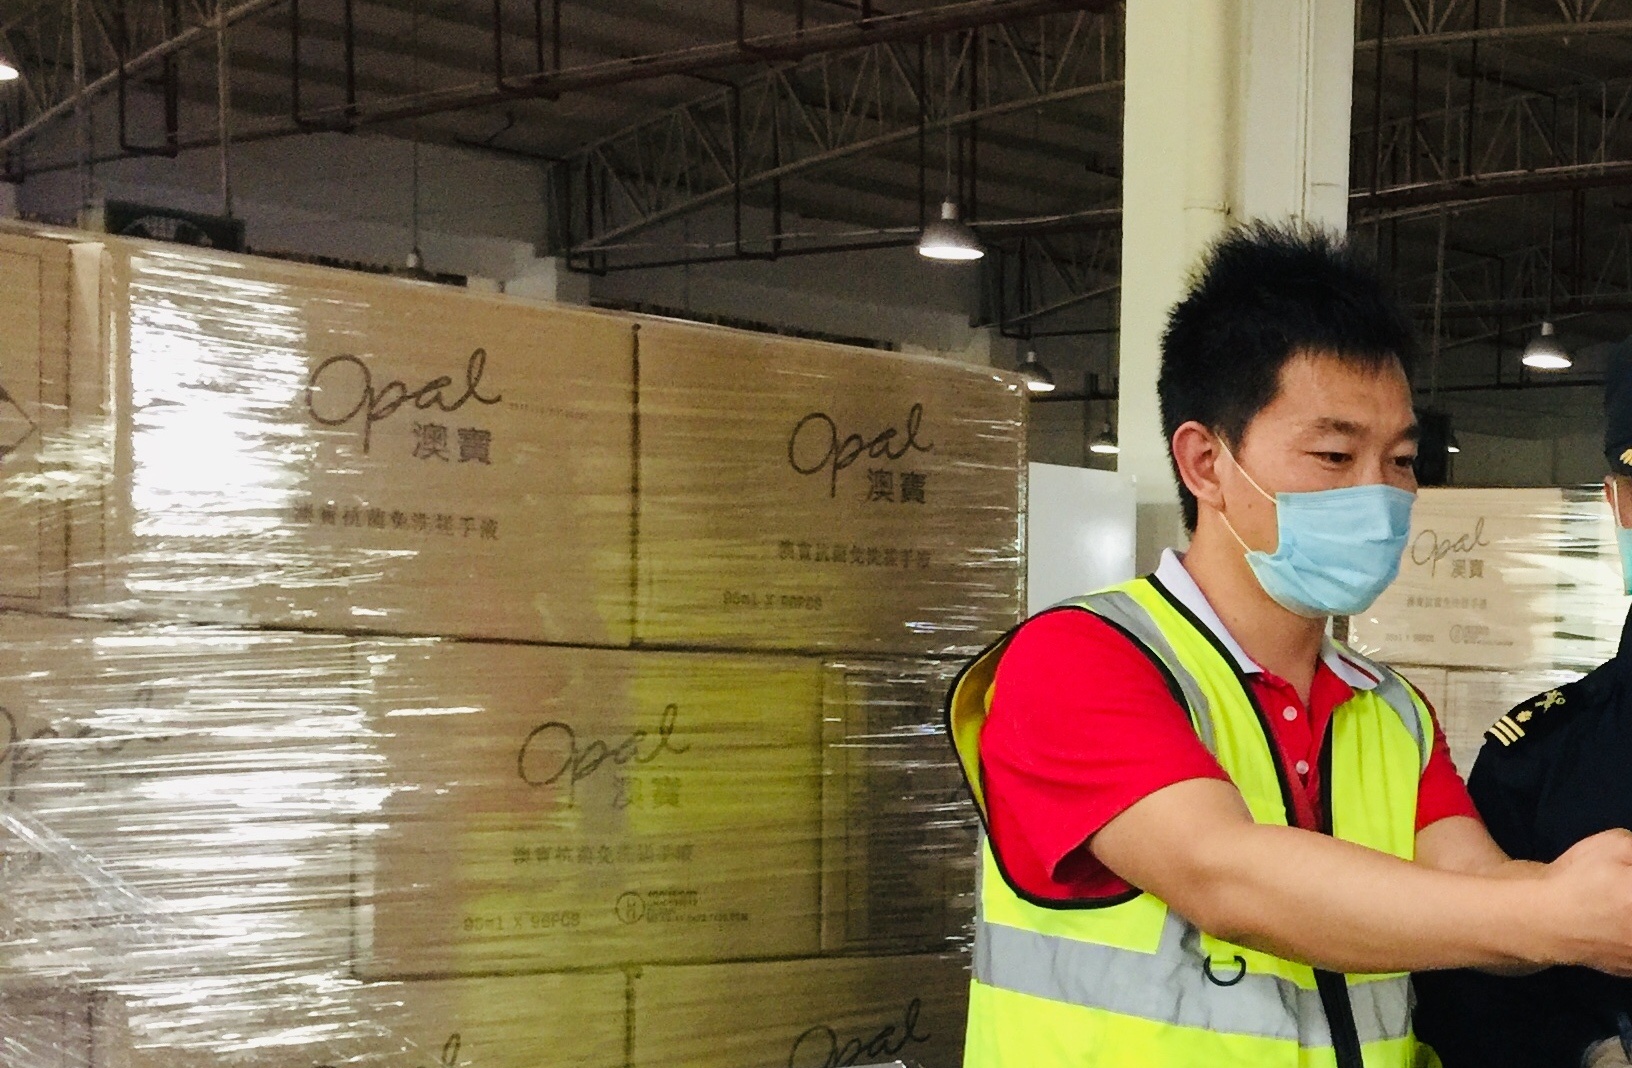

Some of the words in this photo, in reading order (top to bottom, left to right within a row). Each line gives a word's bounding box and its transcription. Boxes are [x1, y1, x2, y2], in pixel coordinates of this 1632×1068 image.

[304, 348, 502, 454] Opal
[788, 403, 933, 499] Opal
[1411, 517, 1490, 577] Opal
[518, 704, 690, 808] Opal
